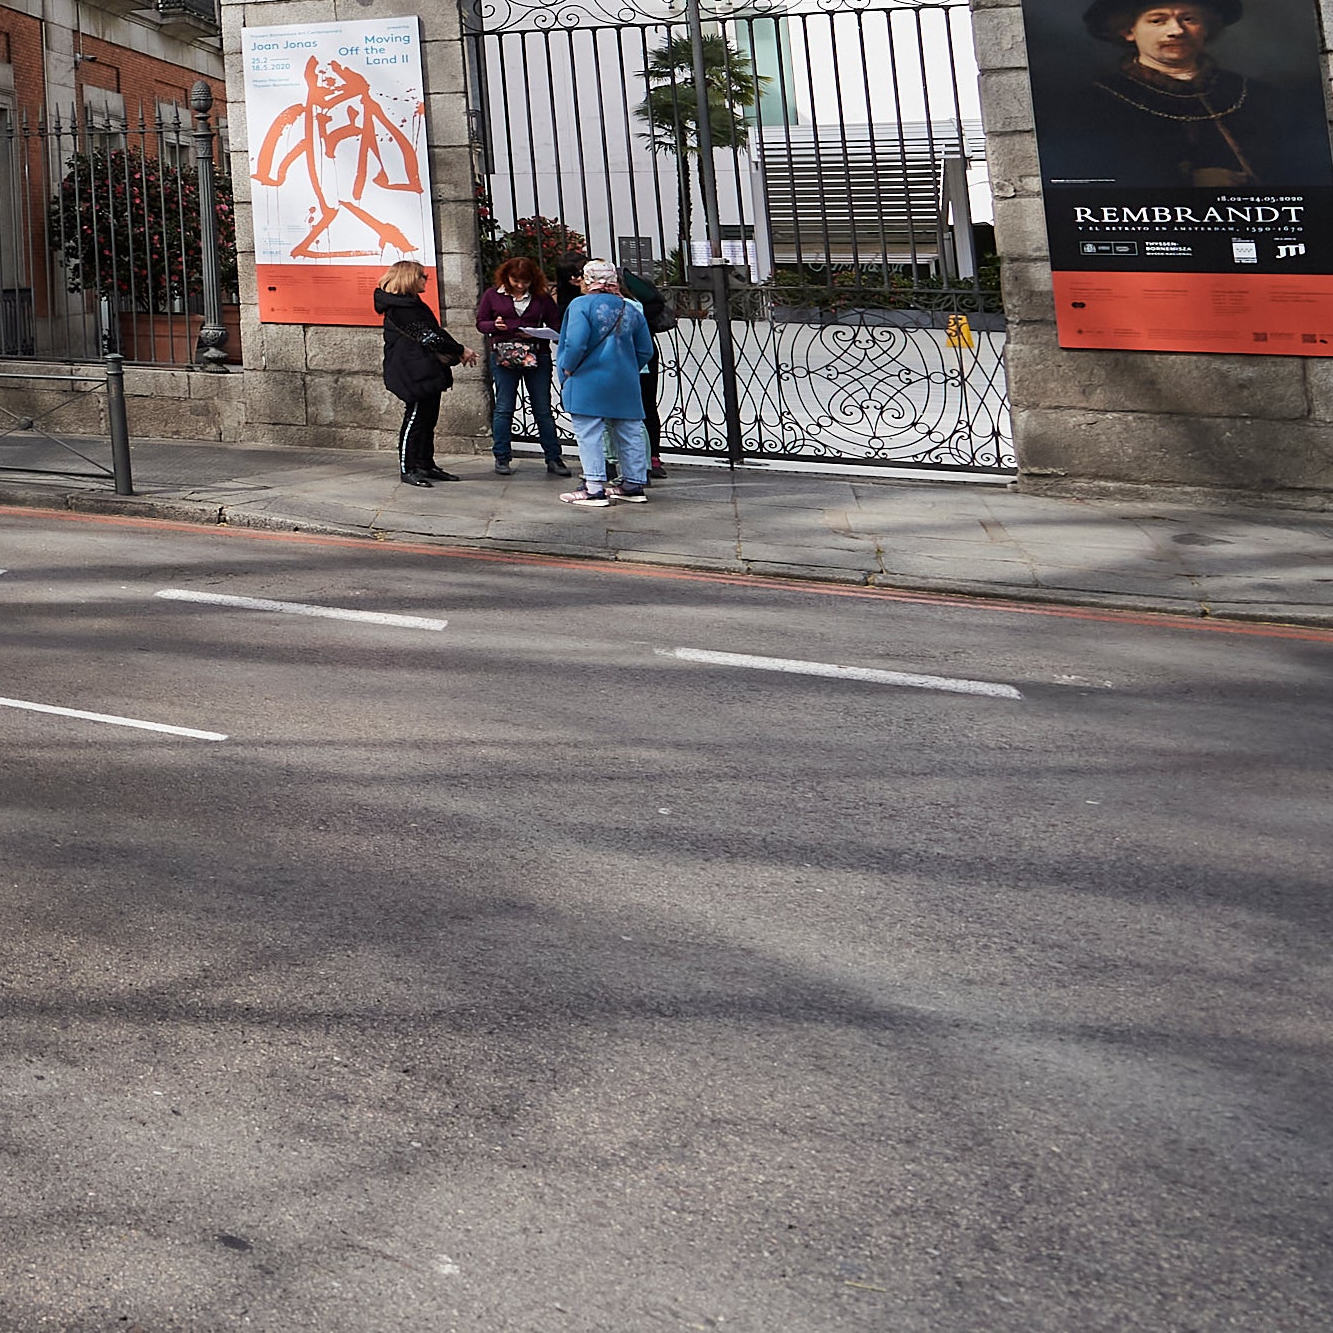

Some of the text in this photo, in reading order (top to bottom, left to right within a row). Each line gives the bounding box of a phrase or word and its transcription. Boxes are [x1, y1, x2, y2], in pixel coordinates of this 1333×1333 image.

[364, 33, 411, 45] Moving
[251, 40, 318, 51] Joan Jonas
[338, 45, 386, 56] Off the
[366, 54, 409, 65] Land II
[252, 63, 291, 71] 18.5.2020
[1073, 206, 1304, 223] REMBRANDT
[1245, 225, 1304, 233] 1590-1670
